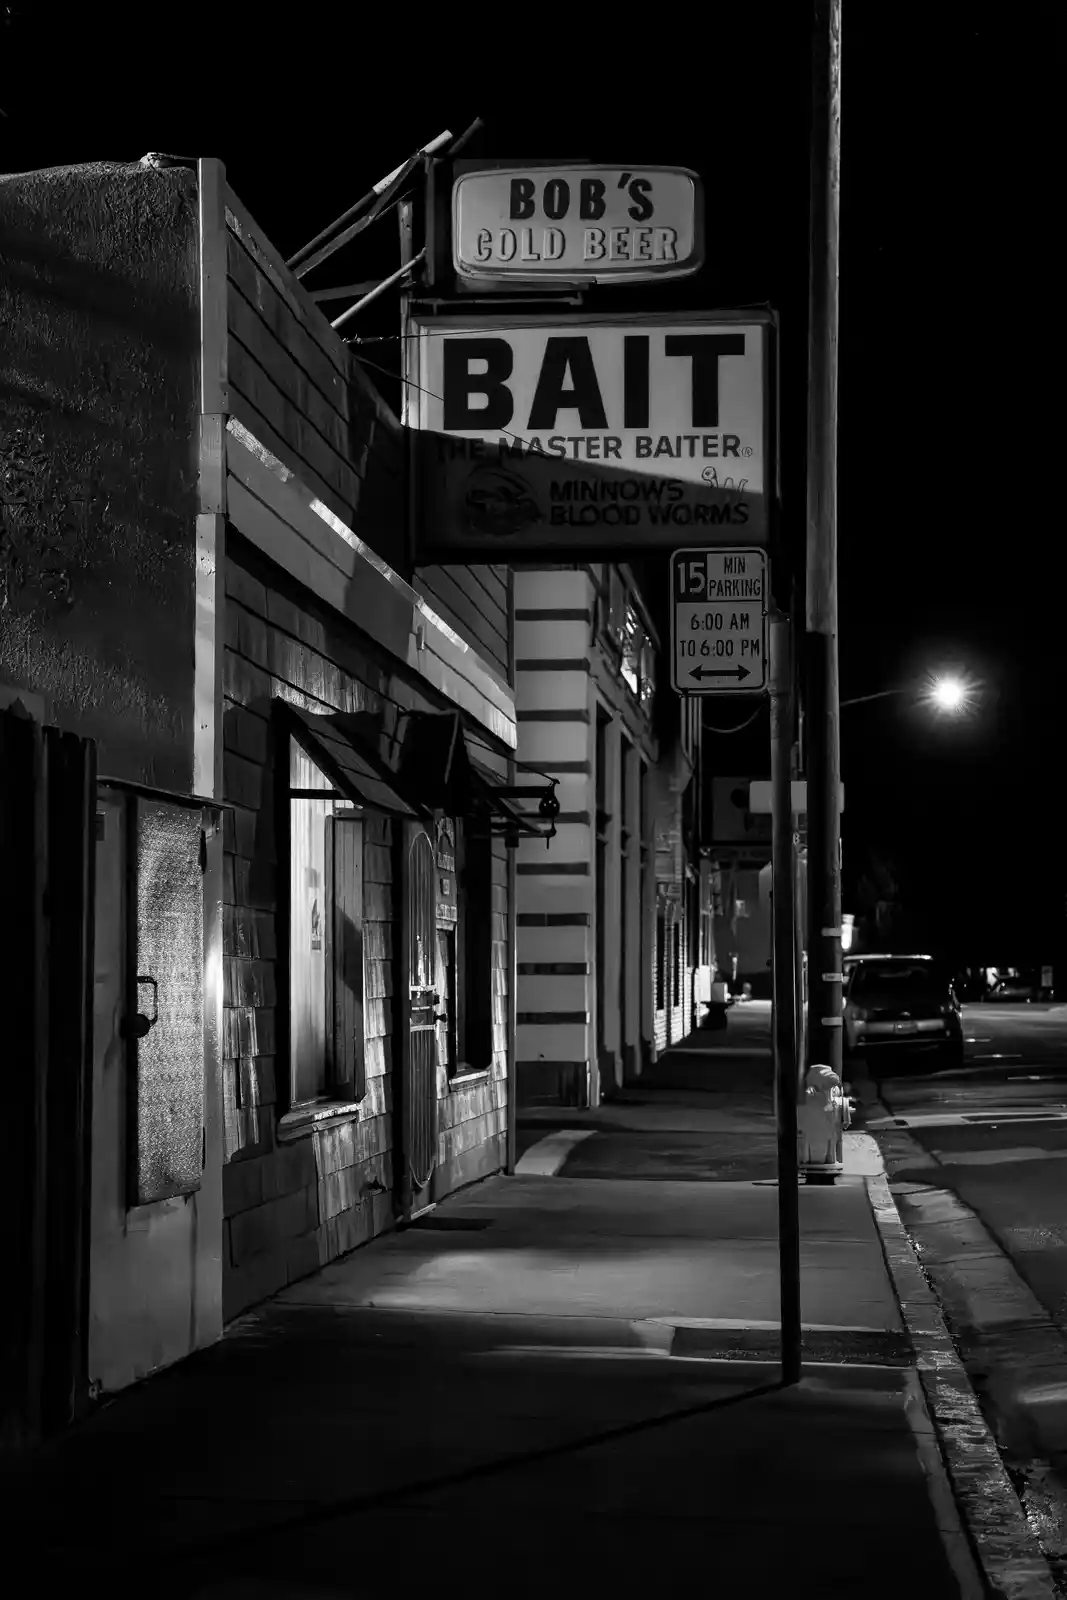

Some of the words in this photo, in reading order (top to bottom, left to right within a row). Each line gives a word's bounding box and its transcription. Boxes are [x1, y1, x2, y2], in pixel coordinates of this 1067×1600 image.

[510, 172, 654, 222] BOB'S
[475, 227, 566, 262] COLD
[583, 227, 678, 262] BEER
[443, 334, 745, 430] BAIT
[436, 437, 484, 461] THE
[499, 435, 622, 460] MASTER
[550, 479, 684, 502] MINNOWS
[550, 503, 641, 526] BLOOD
[649, 503, 749, 526] WORMS
[724, 556, 746, 575] MIN
[677, 561, 707, 596] 15
[709, 579, 761, 597] PARKING
[691, 613, 723, 630] 6:00
[730, 613, 750, 630] AM
[680, 640, 696, 657] TO
[700, 640, 734, 657] 6:00
[741, 639, 760, 657] PM
